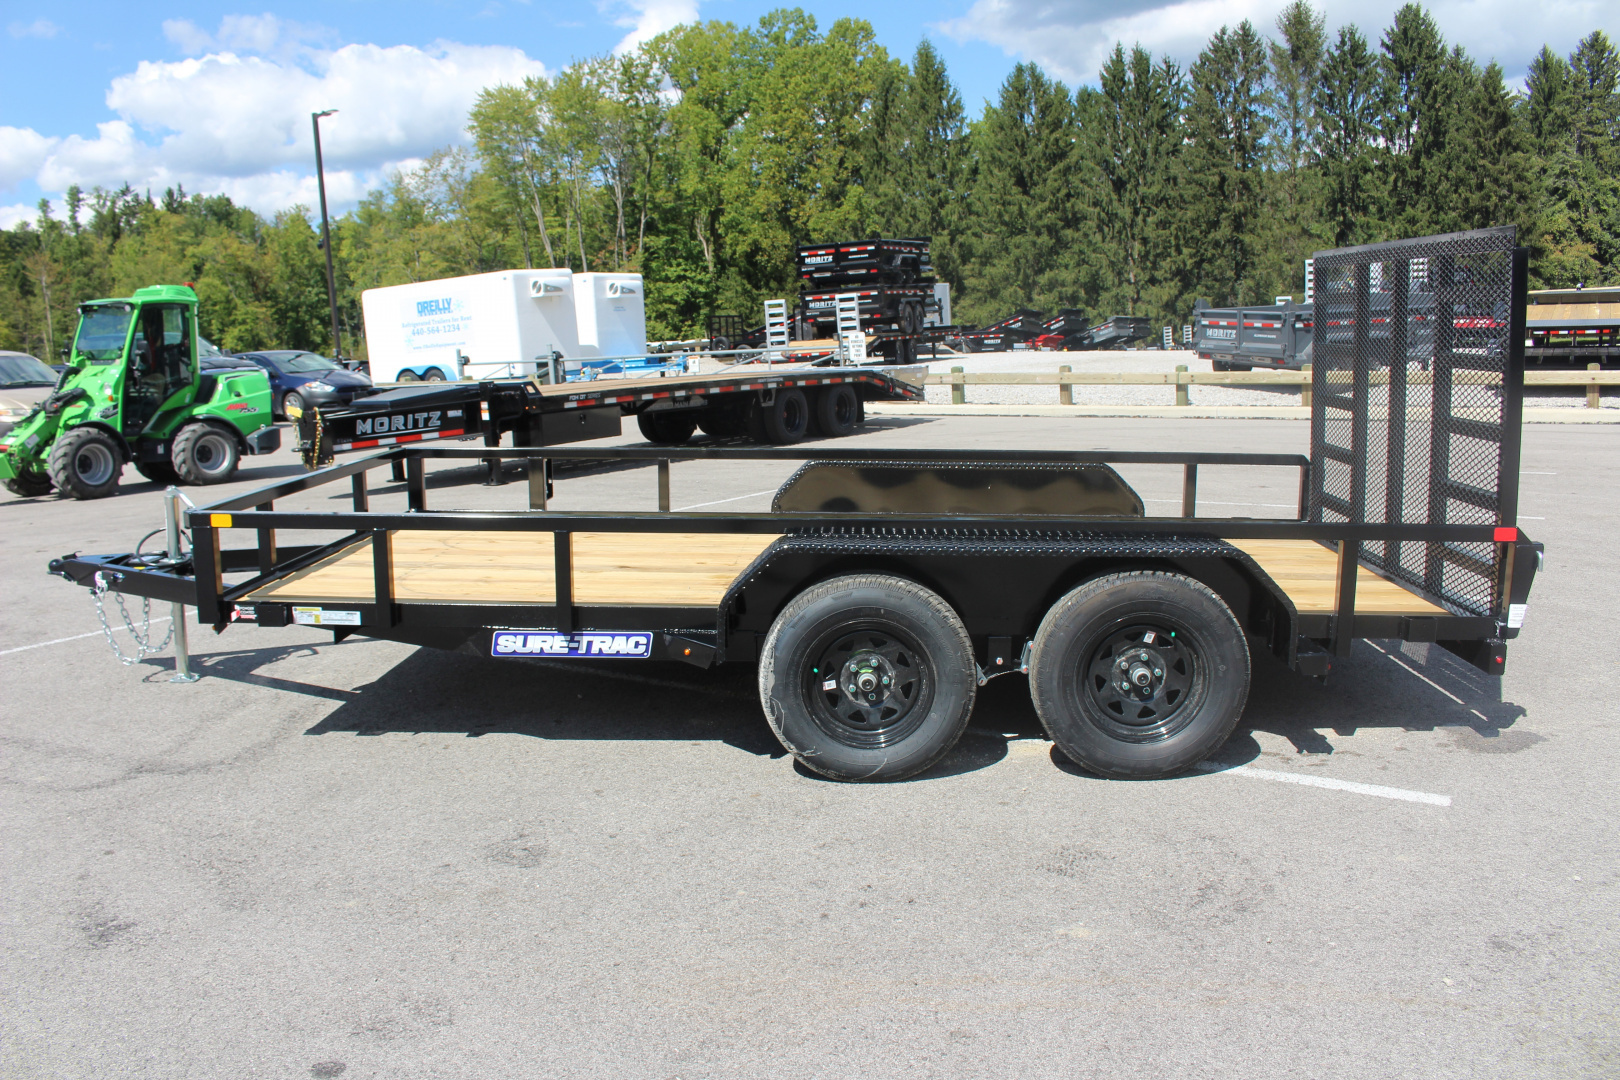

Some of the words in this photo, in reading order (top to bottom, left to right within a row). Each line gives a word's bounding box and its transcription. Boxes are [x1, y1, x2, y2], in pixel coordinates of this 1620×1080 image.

[804, 255, 833, 264] MORITZ
[411, 323, 460, 336] 440-564-1234
[1206, 328, 1237, 338] MORITZ
[356, 411, 441, 435] MORITZ
[496, 634, 647, 655] SURE-TRAC
